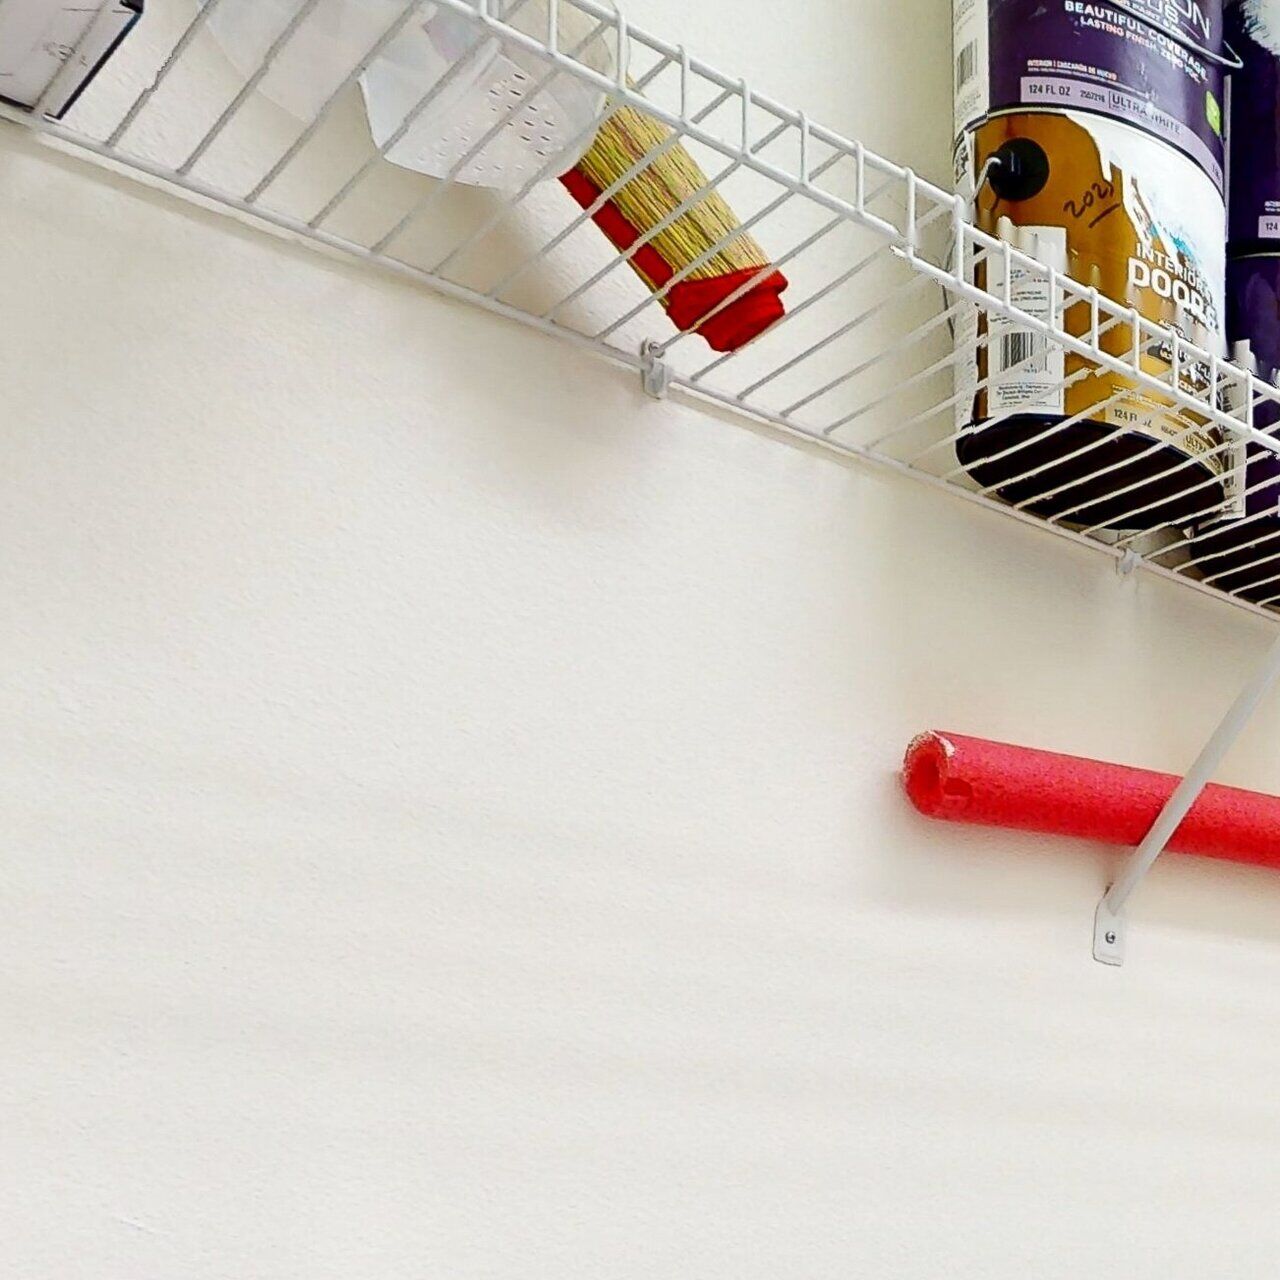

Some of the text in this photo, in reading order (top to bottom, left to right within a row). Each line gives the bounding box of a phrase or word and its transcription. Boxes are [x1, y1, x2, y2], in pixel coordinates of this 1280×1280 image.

[1065, 0, 1146, 34] BEAUTIFUL
[1080, 16, 1125, 37] LASTING
[1029, 84, 1071, 96] 124 FL OZ
[1112, 93, 1147, 116] ULTRA
[1266, 222, 1278, 231] 124
